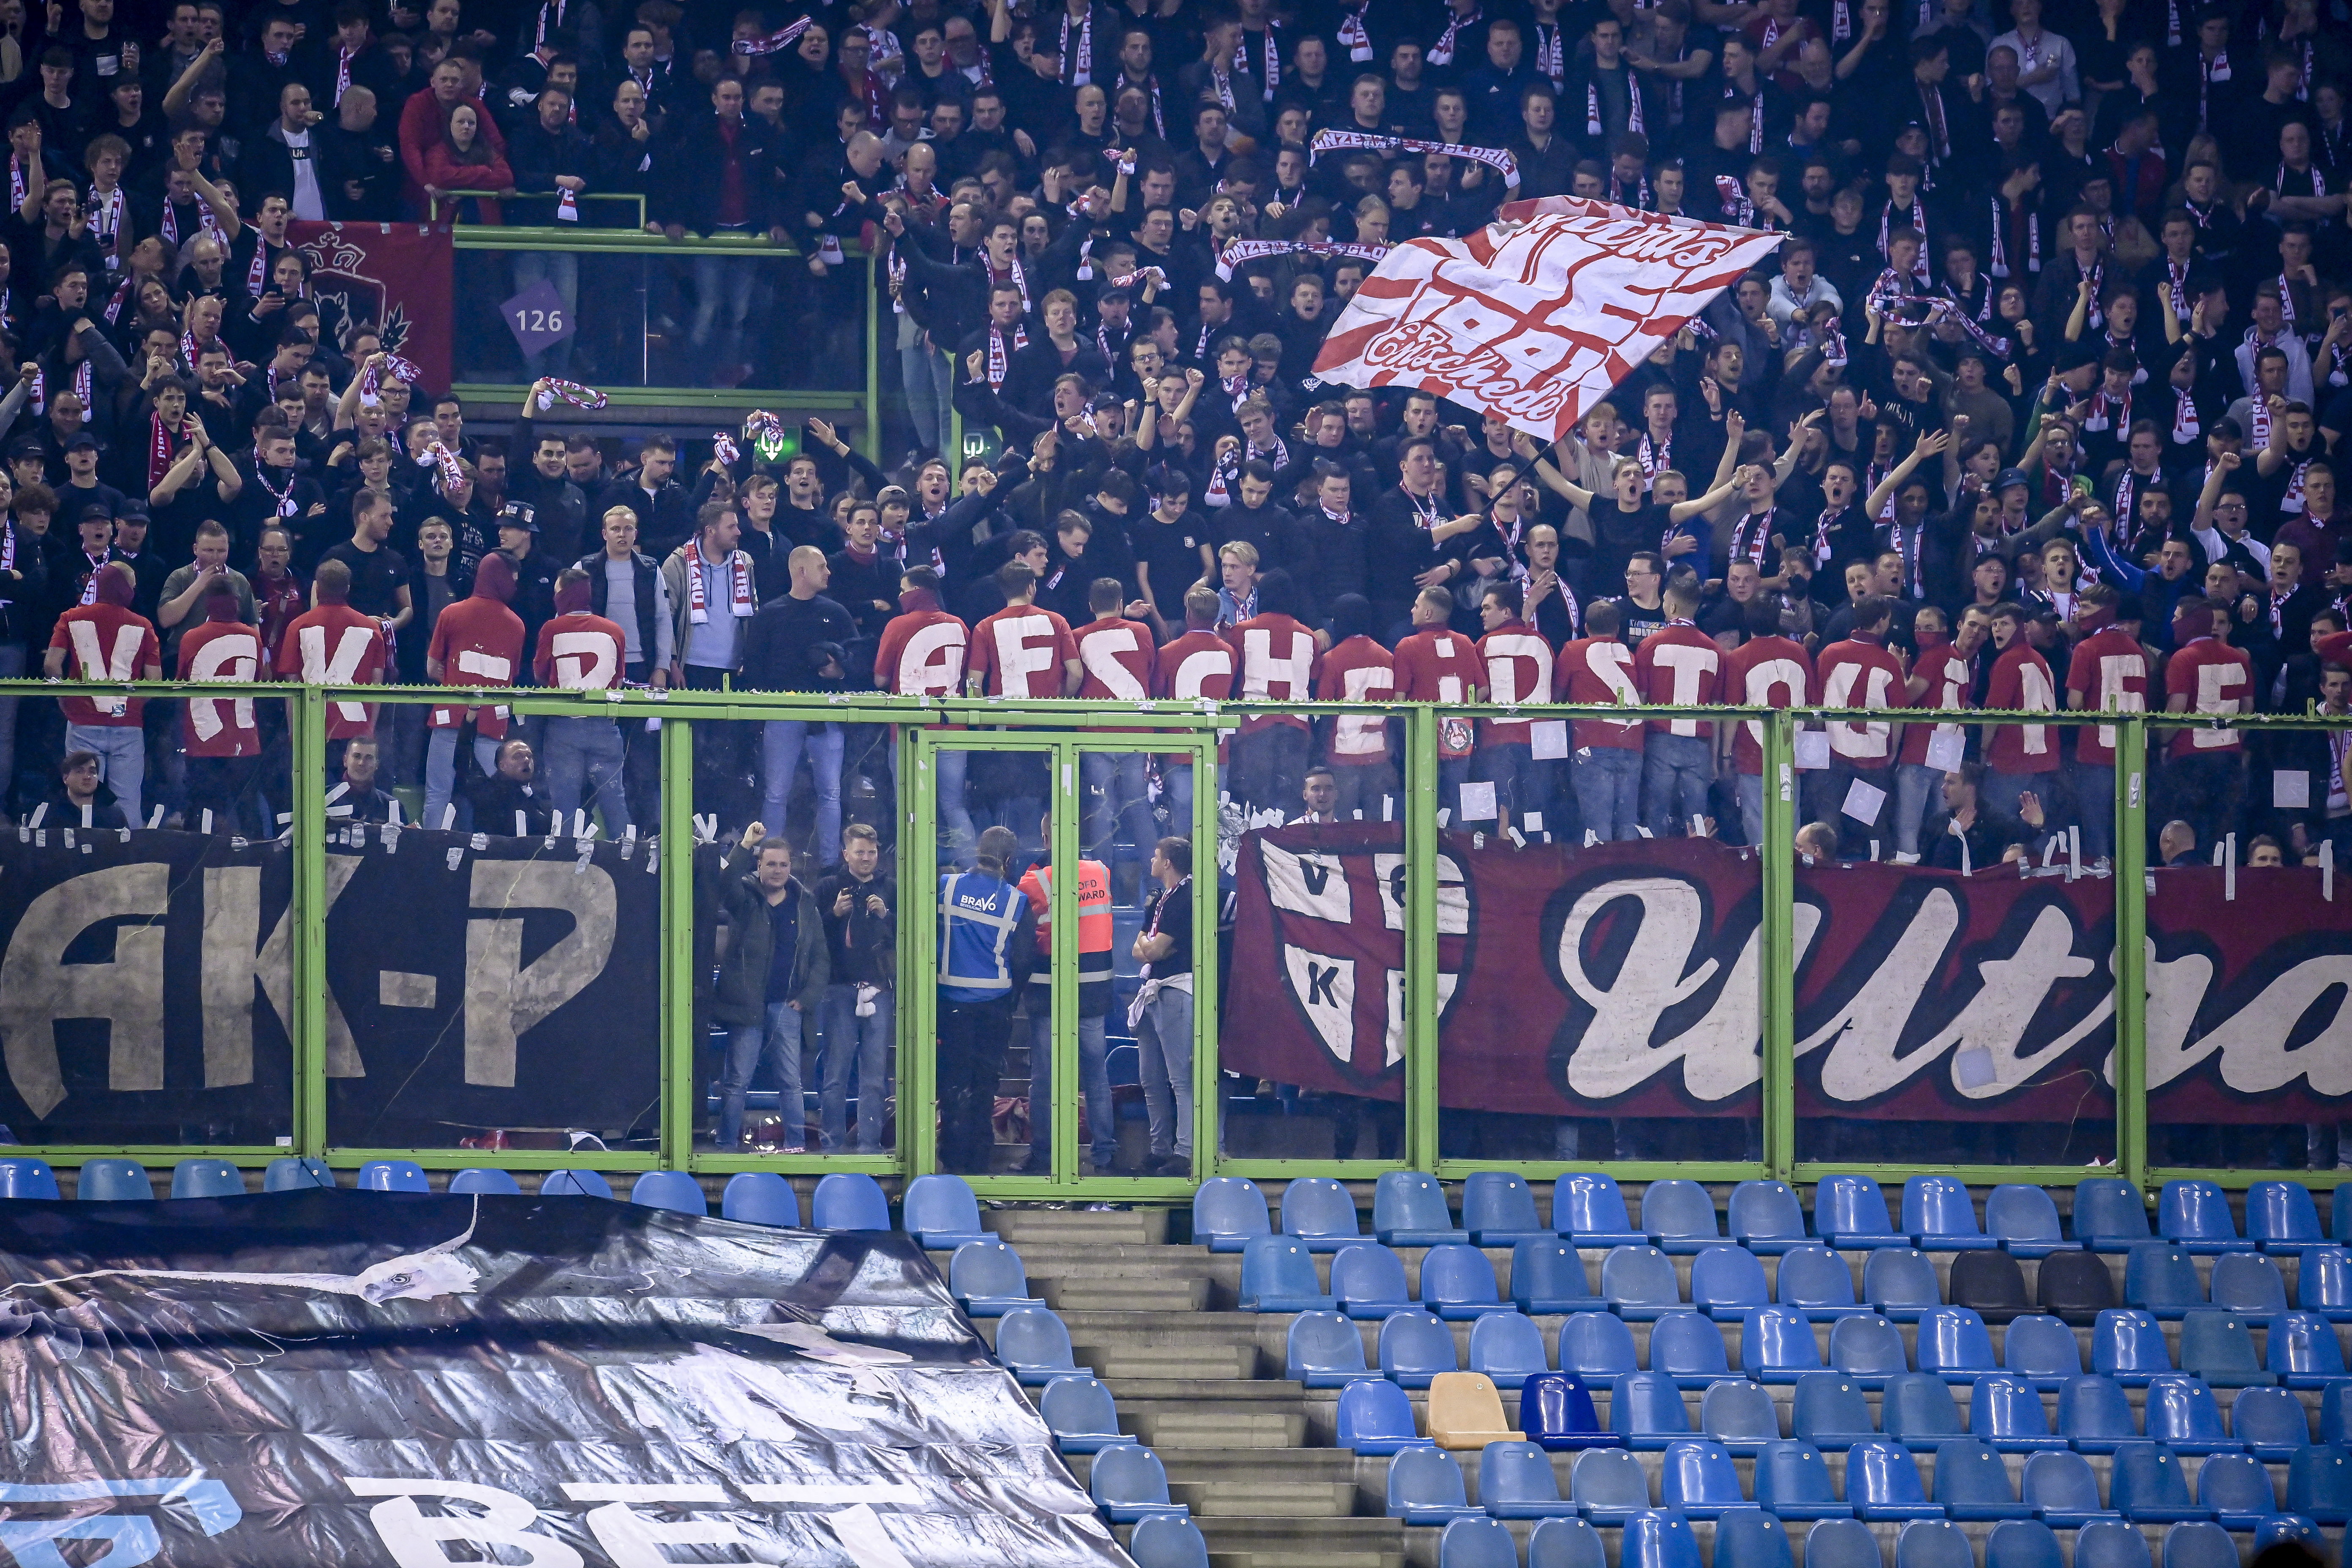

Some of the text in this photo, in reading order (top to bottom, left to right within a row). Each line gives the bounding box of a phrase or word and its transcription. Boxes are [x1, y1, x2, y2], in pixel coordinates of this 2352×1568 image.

[516, 310, 562, 332] 126
[1366, 321, 1562, 420] Enschede
[0, 860, 617, 1121] AK-P
